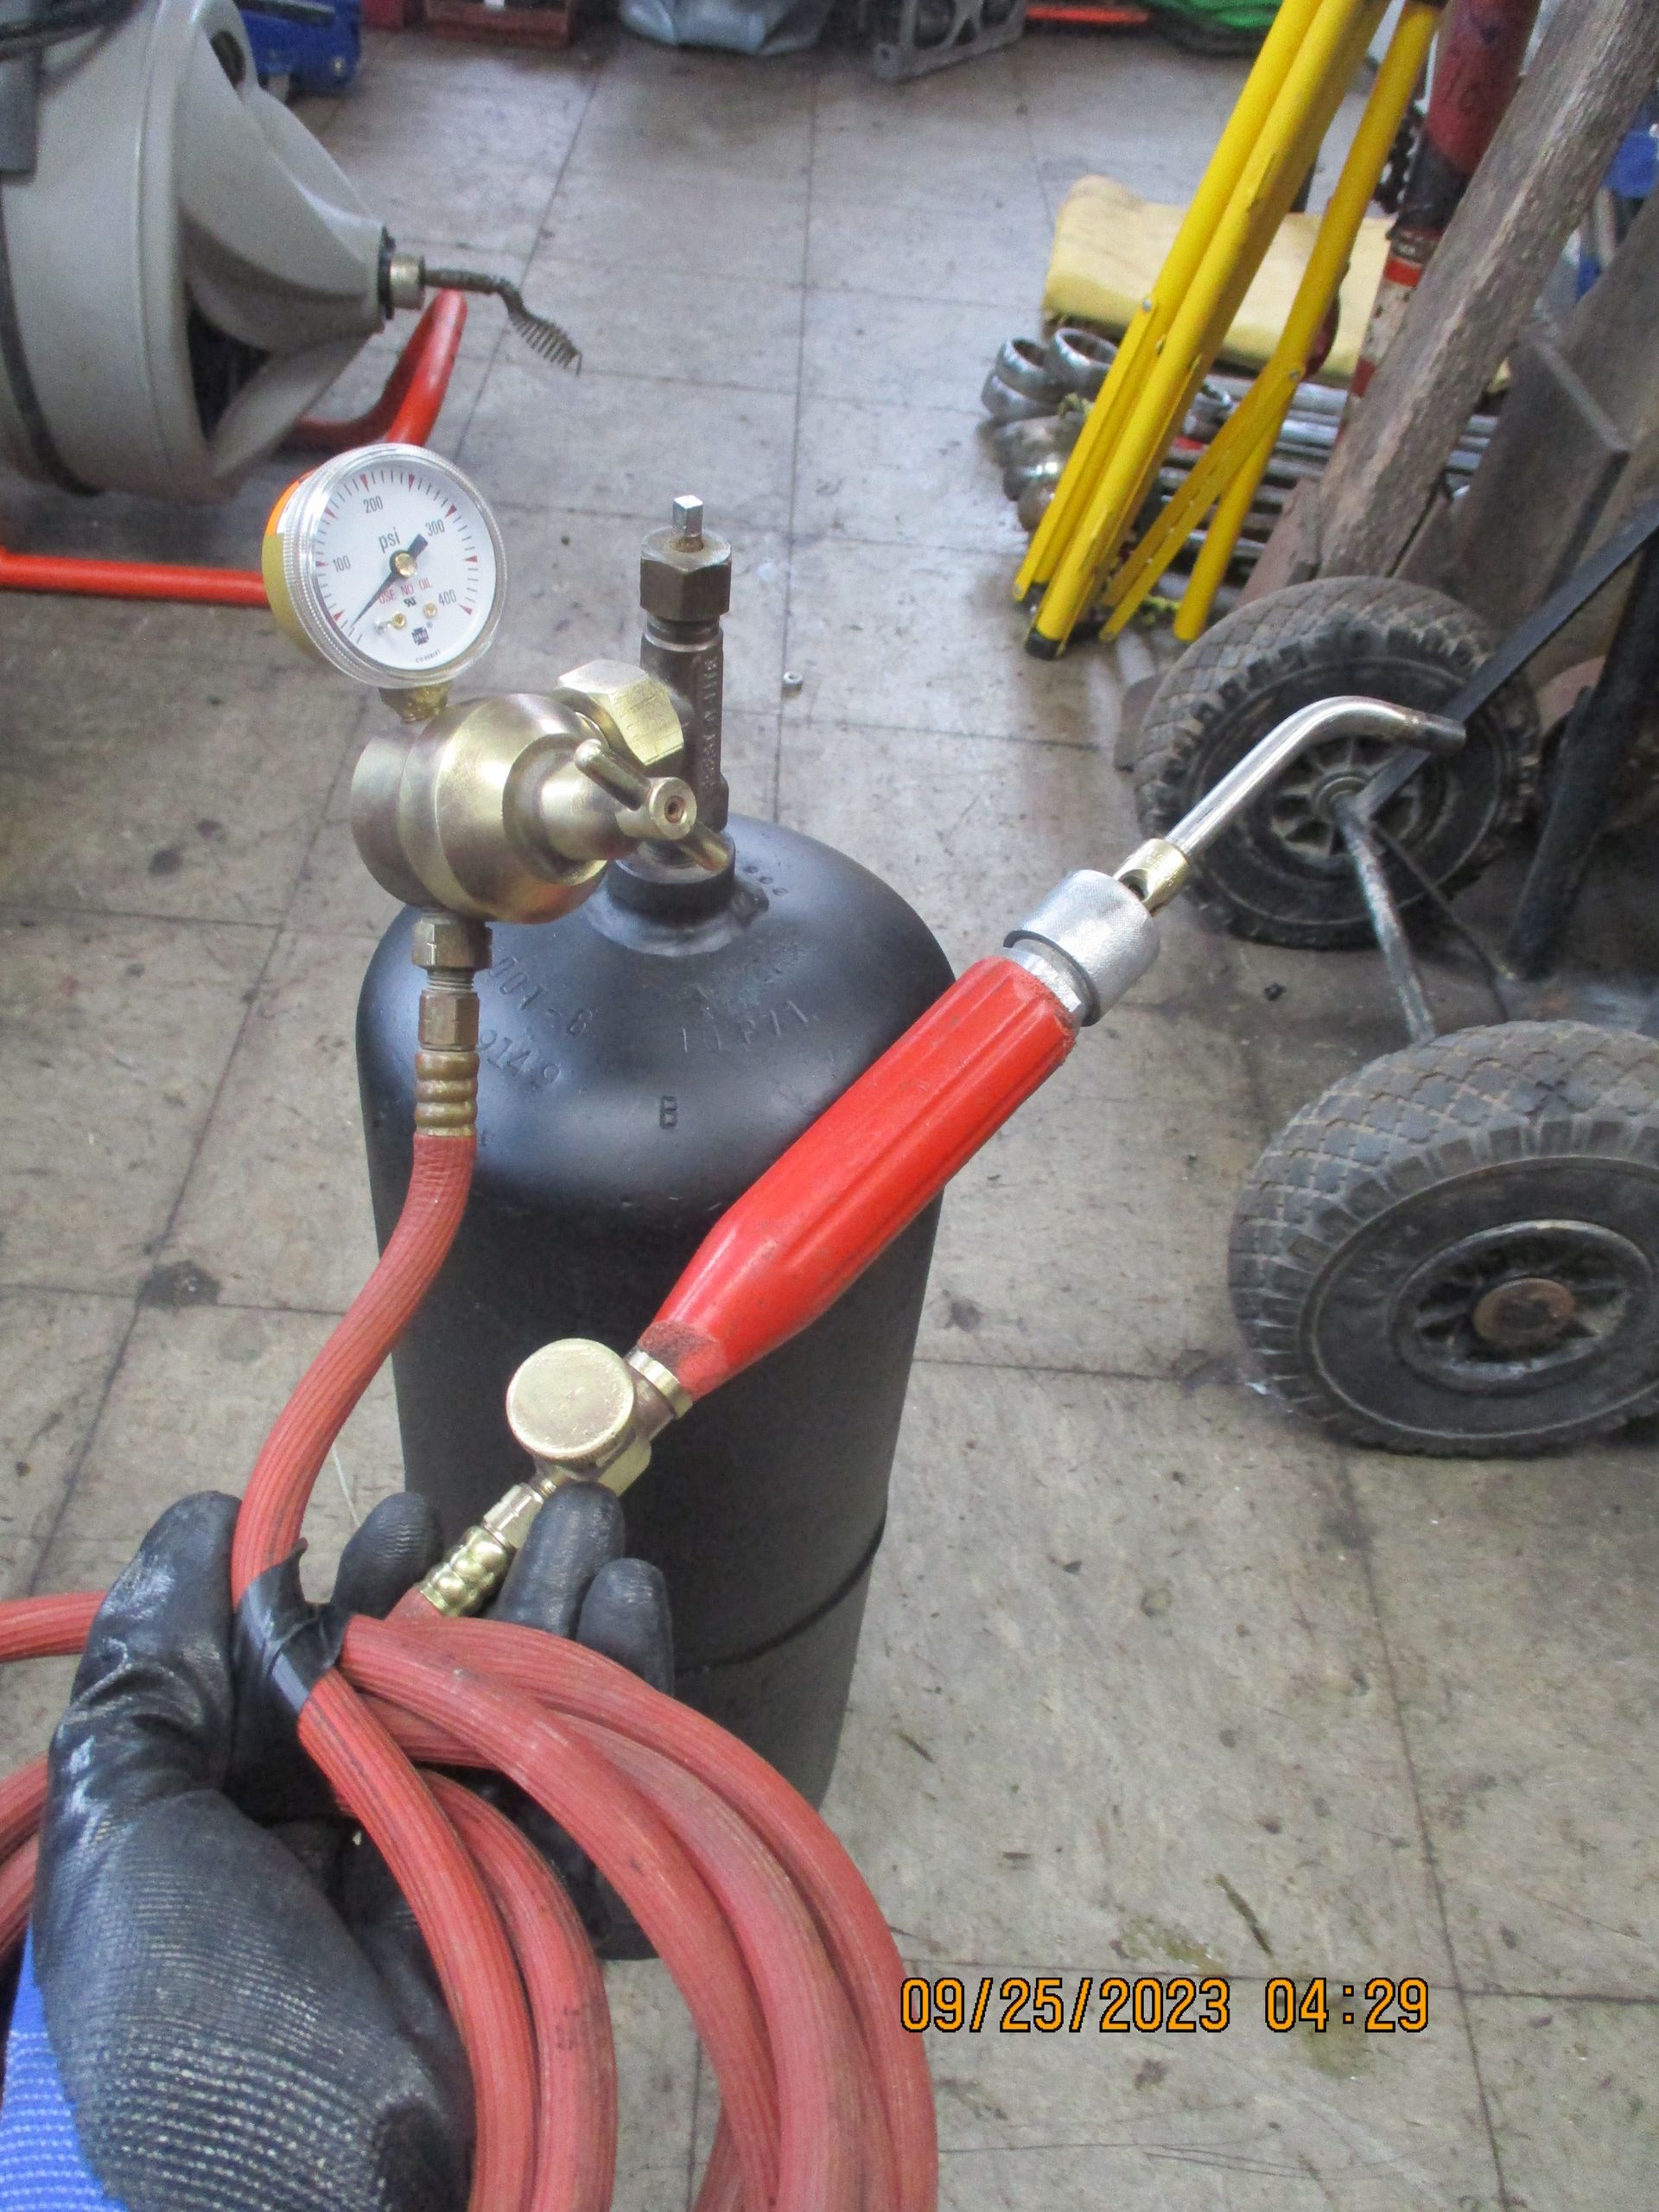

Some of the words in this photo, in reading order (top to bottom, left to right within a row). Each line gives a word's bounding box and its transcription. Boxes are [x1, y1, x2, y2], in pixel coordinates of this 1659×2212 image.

[363, 496, 384, 513] 200
[425, 519, 445, 537] 300
[378, 526, 401, 553] psi
[333, 556, 351, 573] 100
[401, 582, 415, 596] NO
[418, 578, 432, 591] OIL
[438, 589, 457, 607] 400
